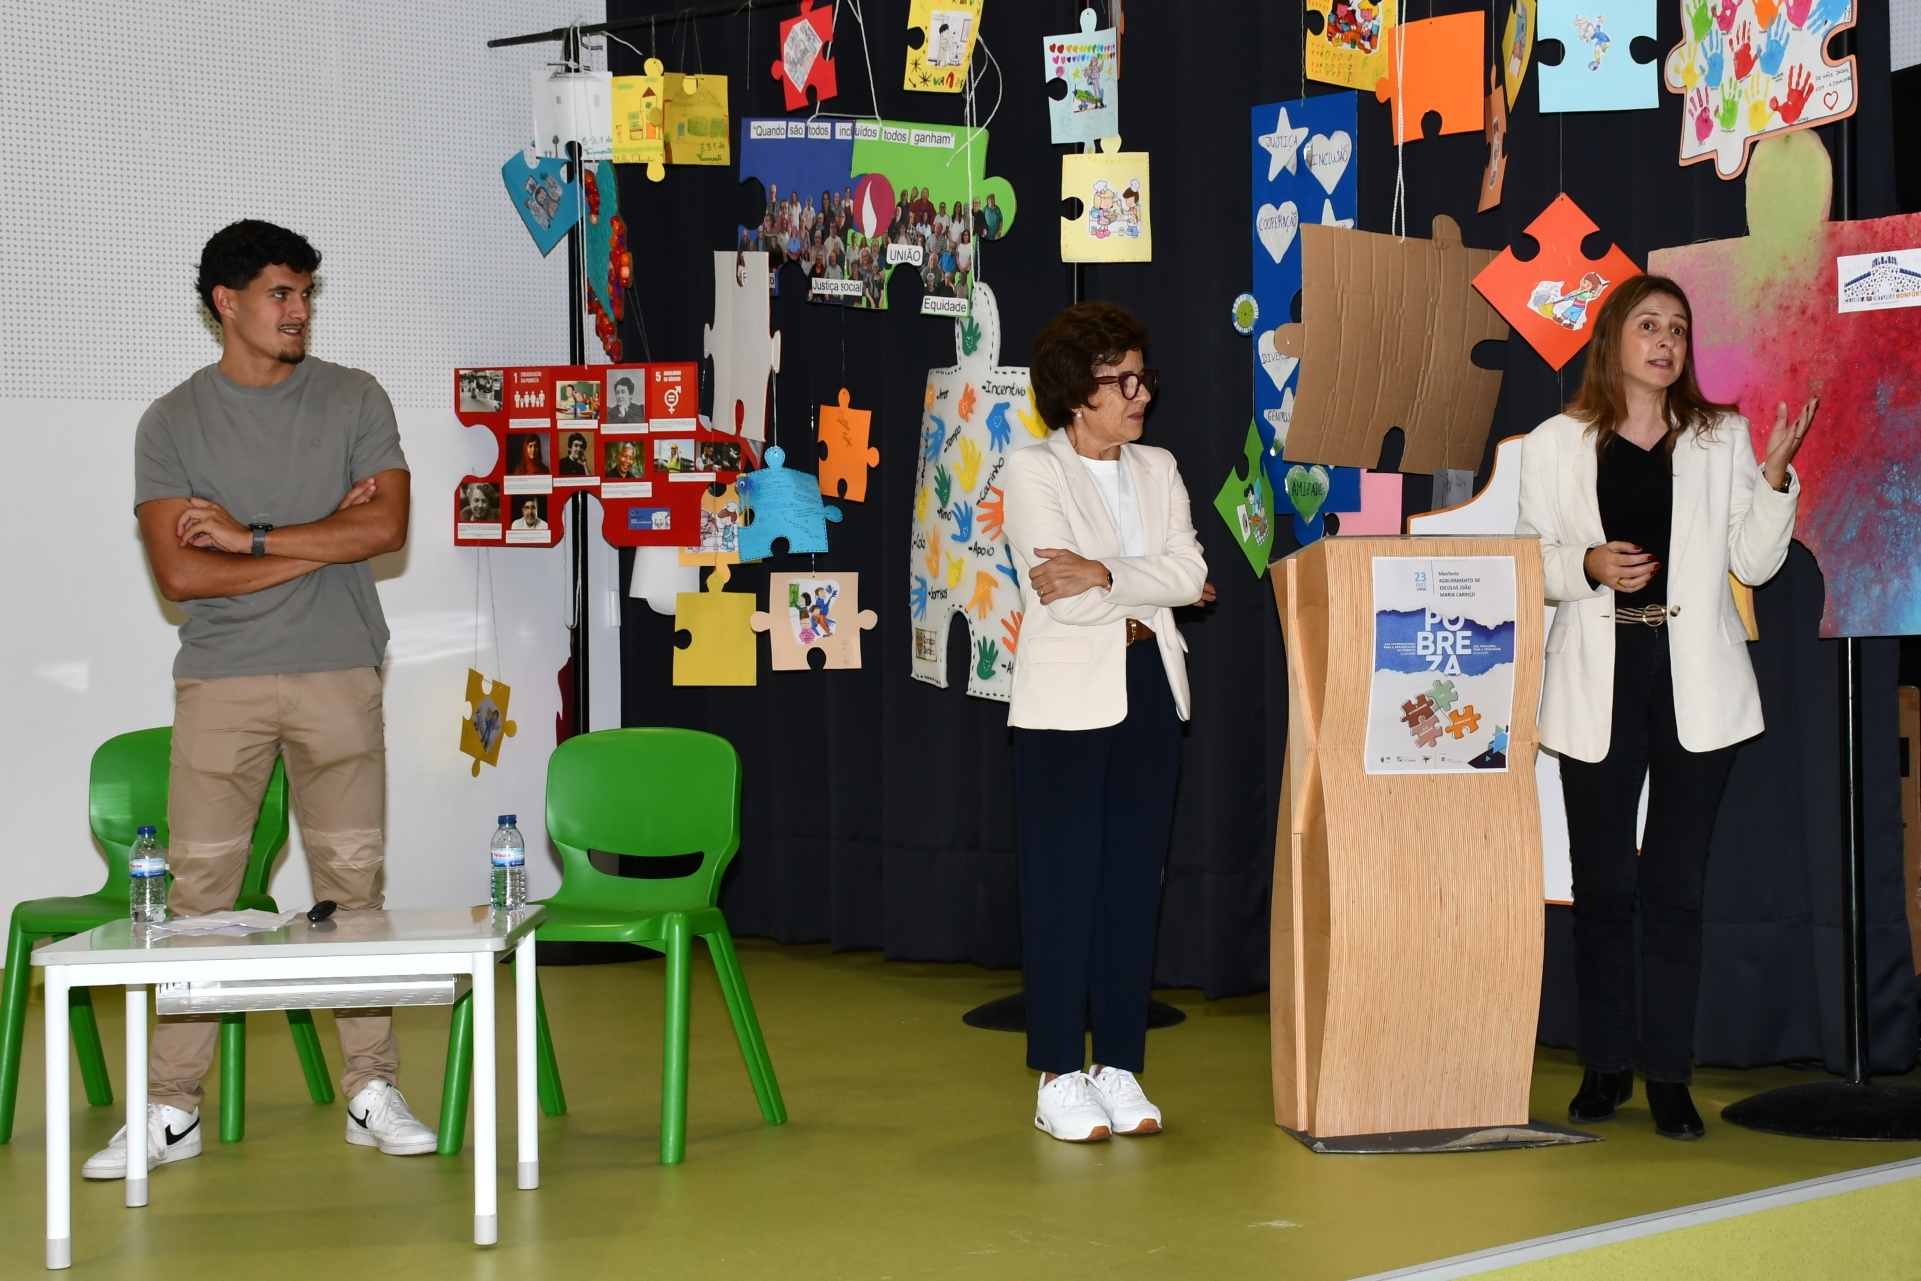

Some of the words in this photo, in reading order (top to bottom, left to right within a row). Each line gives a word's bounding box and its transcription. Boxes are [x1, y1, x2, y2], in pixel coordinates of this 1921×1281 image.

[789, 126, 803, 136] são
[808, 125, 829, 136] todos
[839, 124, 878, 138] incluídos
[883, 128, 907, 142] todos
[1266, 134, 1298, 151] JUSTIÇA
[1311, 144, 1349, 166] INCLUSÃO
[1259, 211, 1298, 233] COOPERAÇÃO
[889, 248, 921, 262] UNIÃO
[812, 278, 839, 293] Justiça
[841, 280, 863, 293] social
[924, 297, 967, 314] Equidade
[513, 372, 518, 384] 1
[655, 371, 661, 382] 5
[1291, 478, 1324, 498] AMIZADE
[1414, 572, 1426, 582] 23
[1425, 607, 1465, 631] PO
[1417, 631, 1472, 655] BRE
[1425, 654, 1462, 676] ZA
